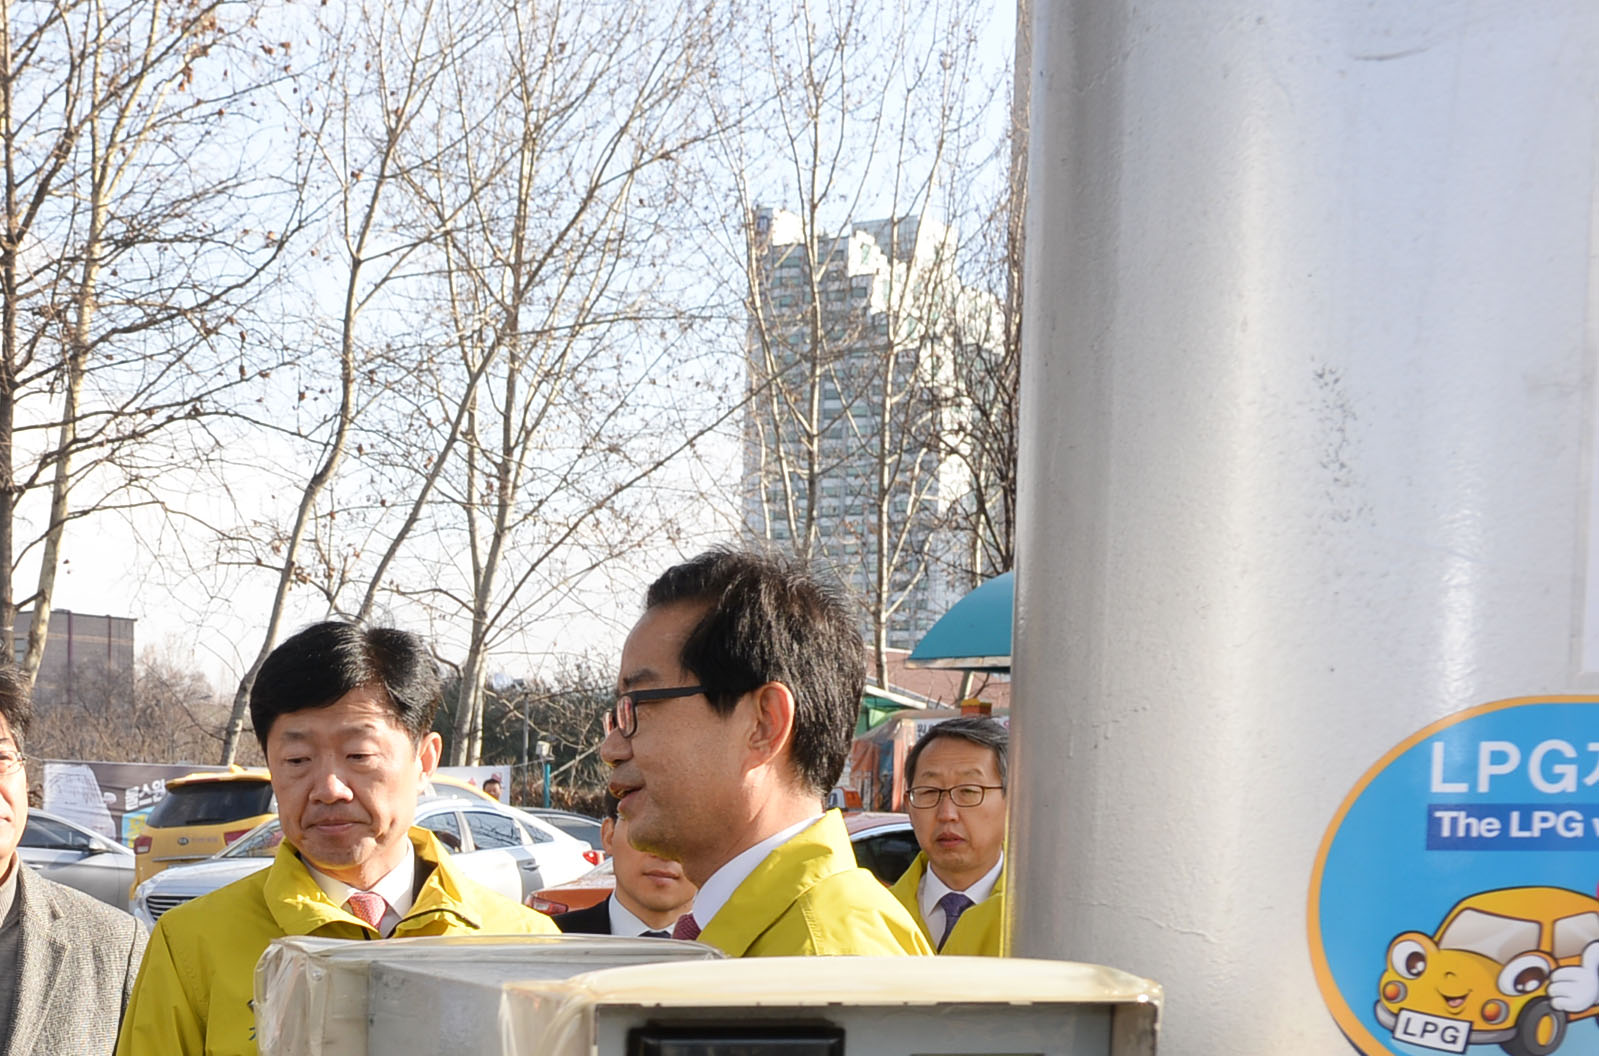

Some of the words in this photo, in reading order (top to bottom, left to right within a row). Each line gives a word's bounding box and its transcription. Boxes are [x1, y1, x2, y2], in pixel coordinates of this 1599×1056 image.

[1431, 739, 1599, 793] LPG
[1434, 810, 1502, 838] The
[1509, 810, 1585, 838] LPG
[1402, 1016, 1461, 1045] LPG
